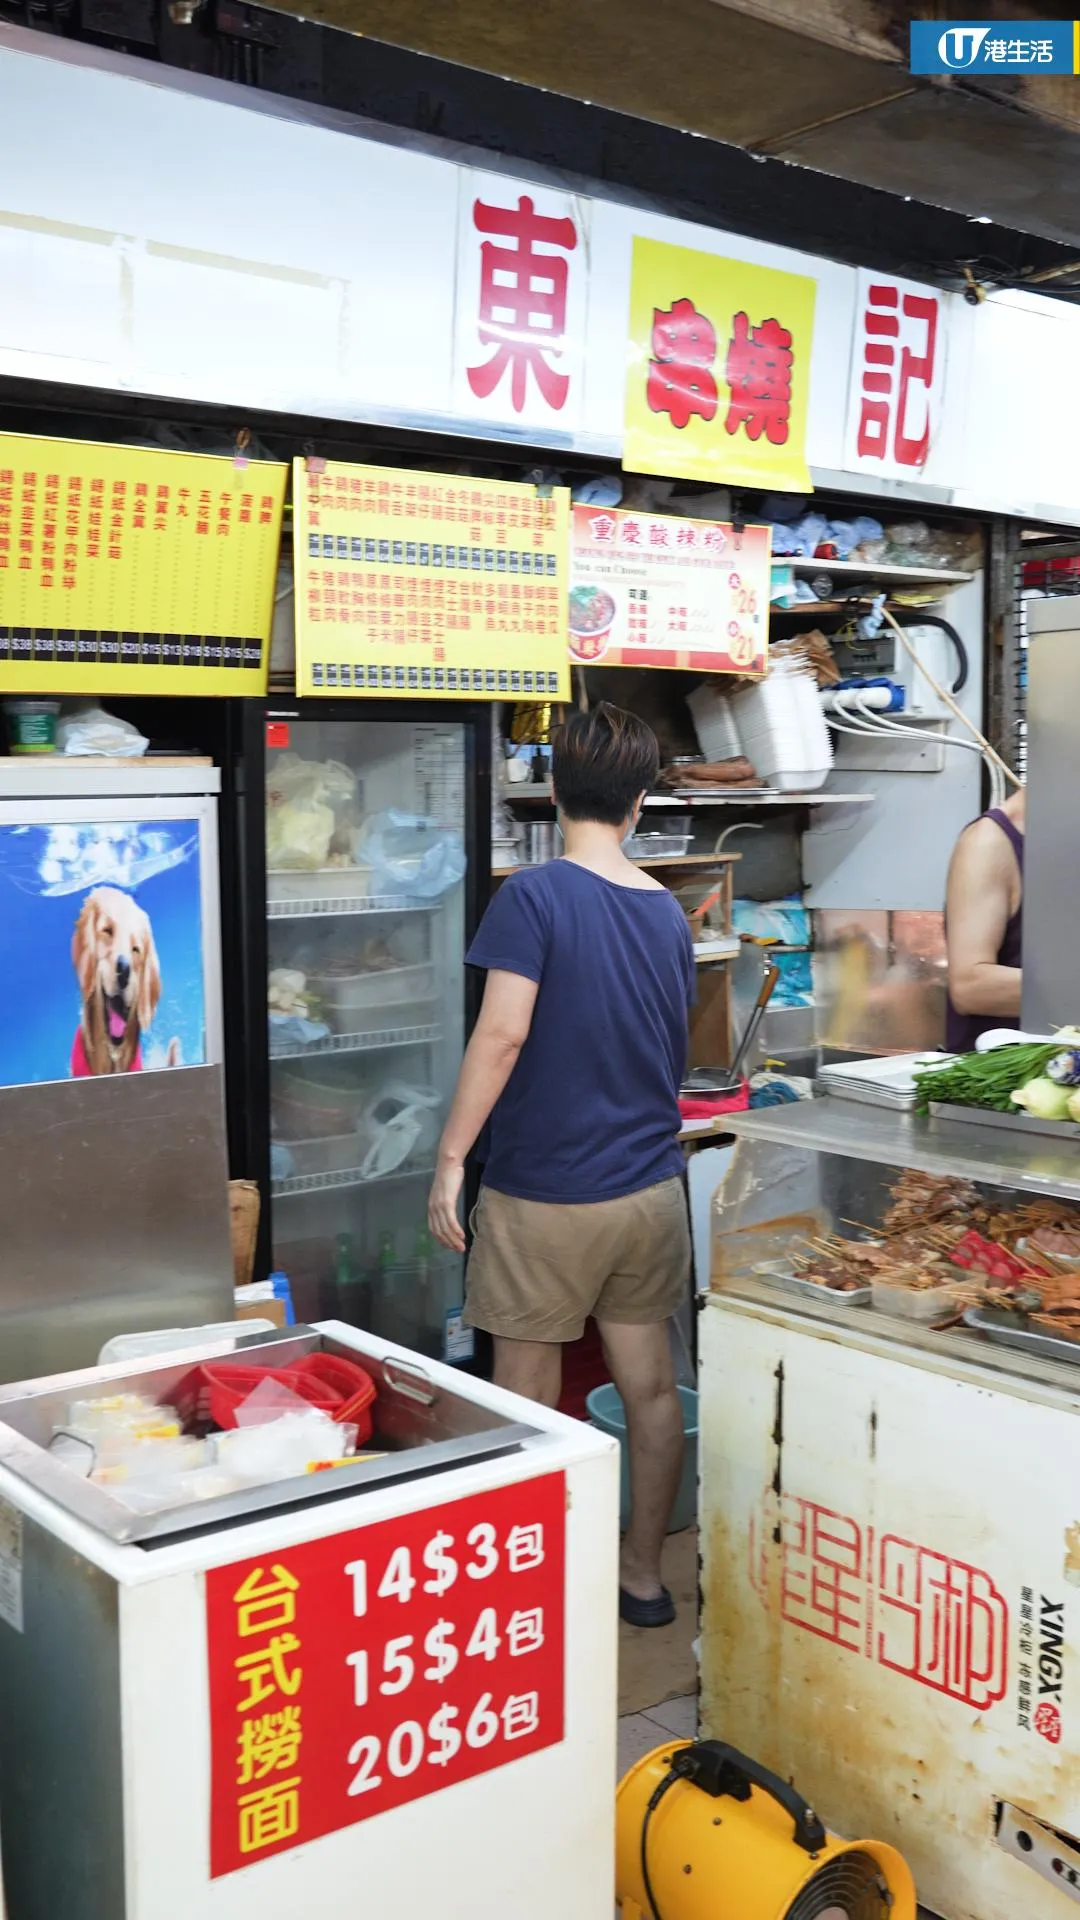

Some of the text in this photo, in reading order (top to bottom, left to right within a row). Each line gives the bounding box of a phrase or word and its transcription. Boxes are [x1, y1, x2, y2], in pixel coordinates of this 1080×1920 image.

[466, 194, 938, 467] 東 串燒 記
[176, 488, 191, 517] 牛丸
[592, 518, 727, 553] 重慶酸辣粉
[343, 1521, 545, 1617] 14$3包
[344, 1606, 545, 1707] 15$4包
[232, 1563, 303, 1853] 台式撈面
[346, 1691, 540, 1797] 20$6包
